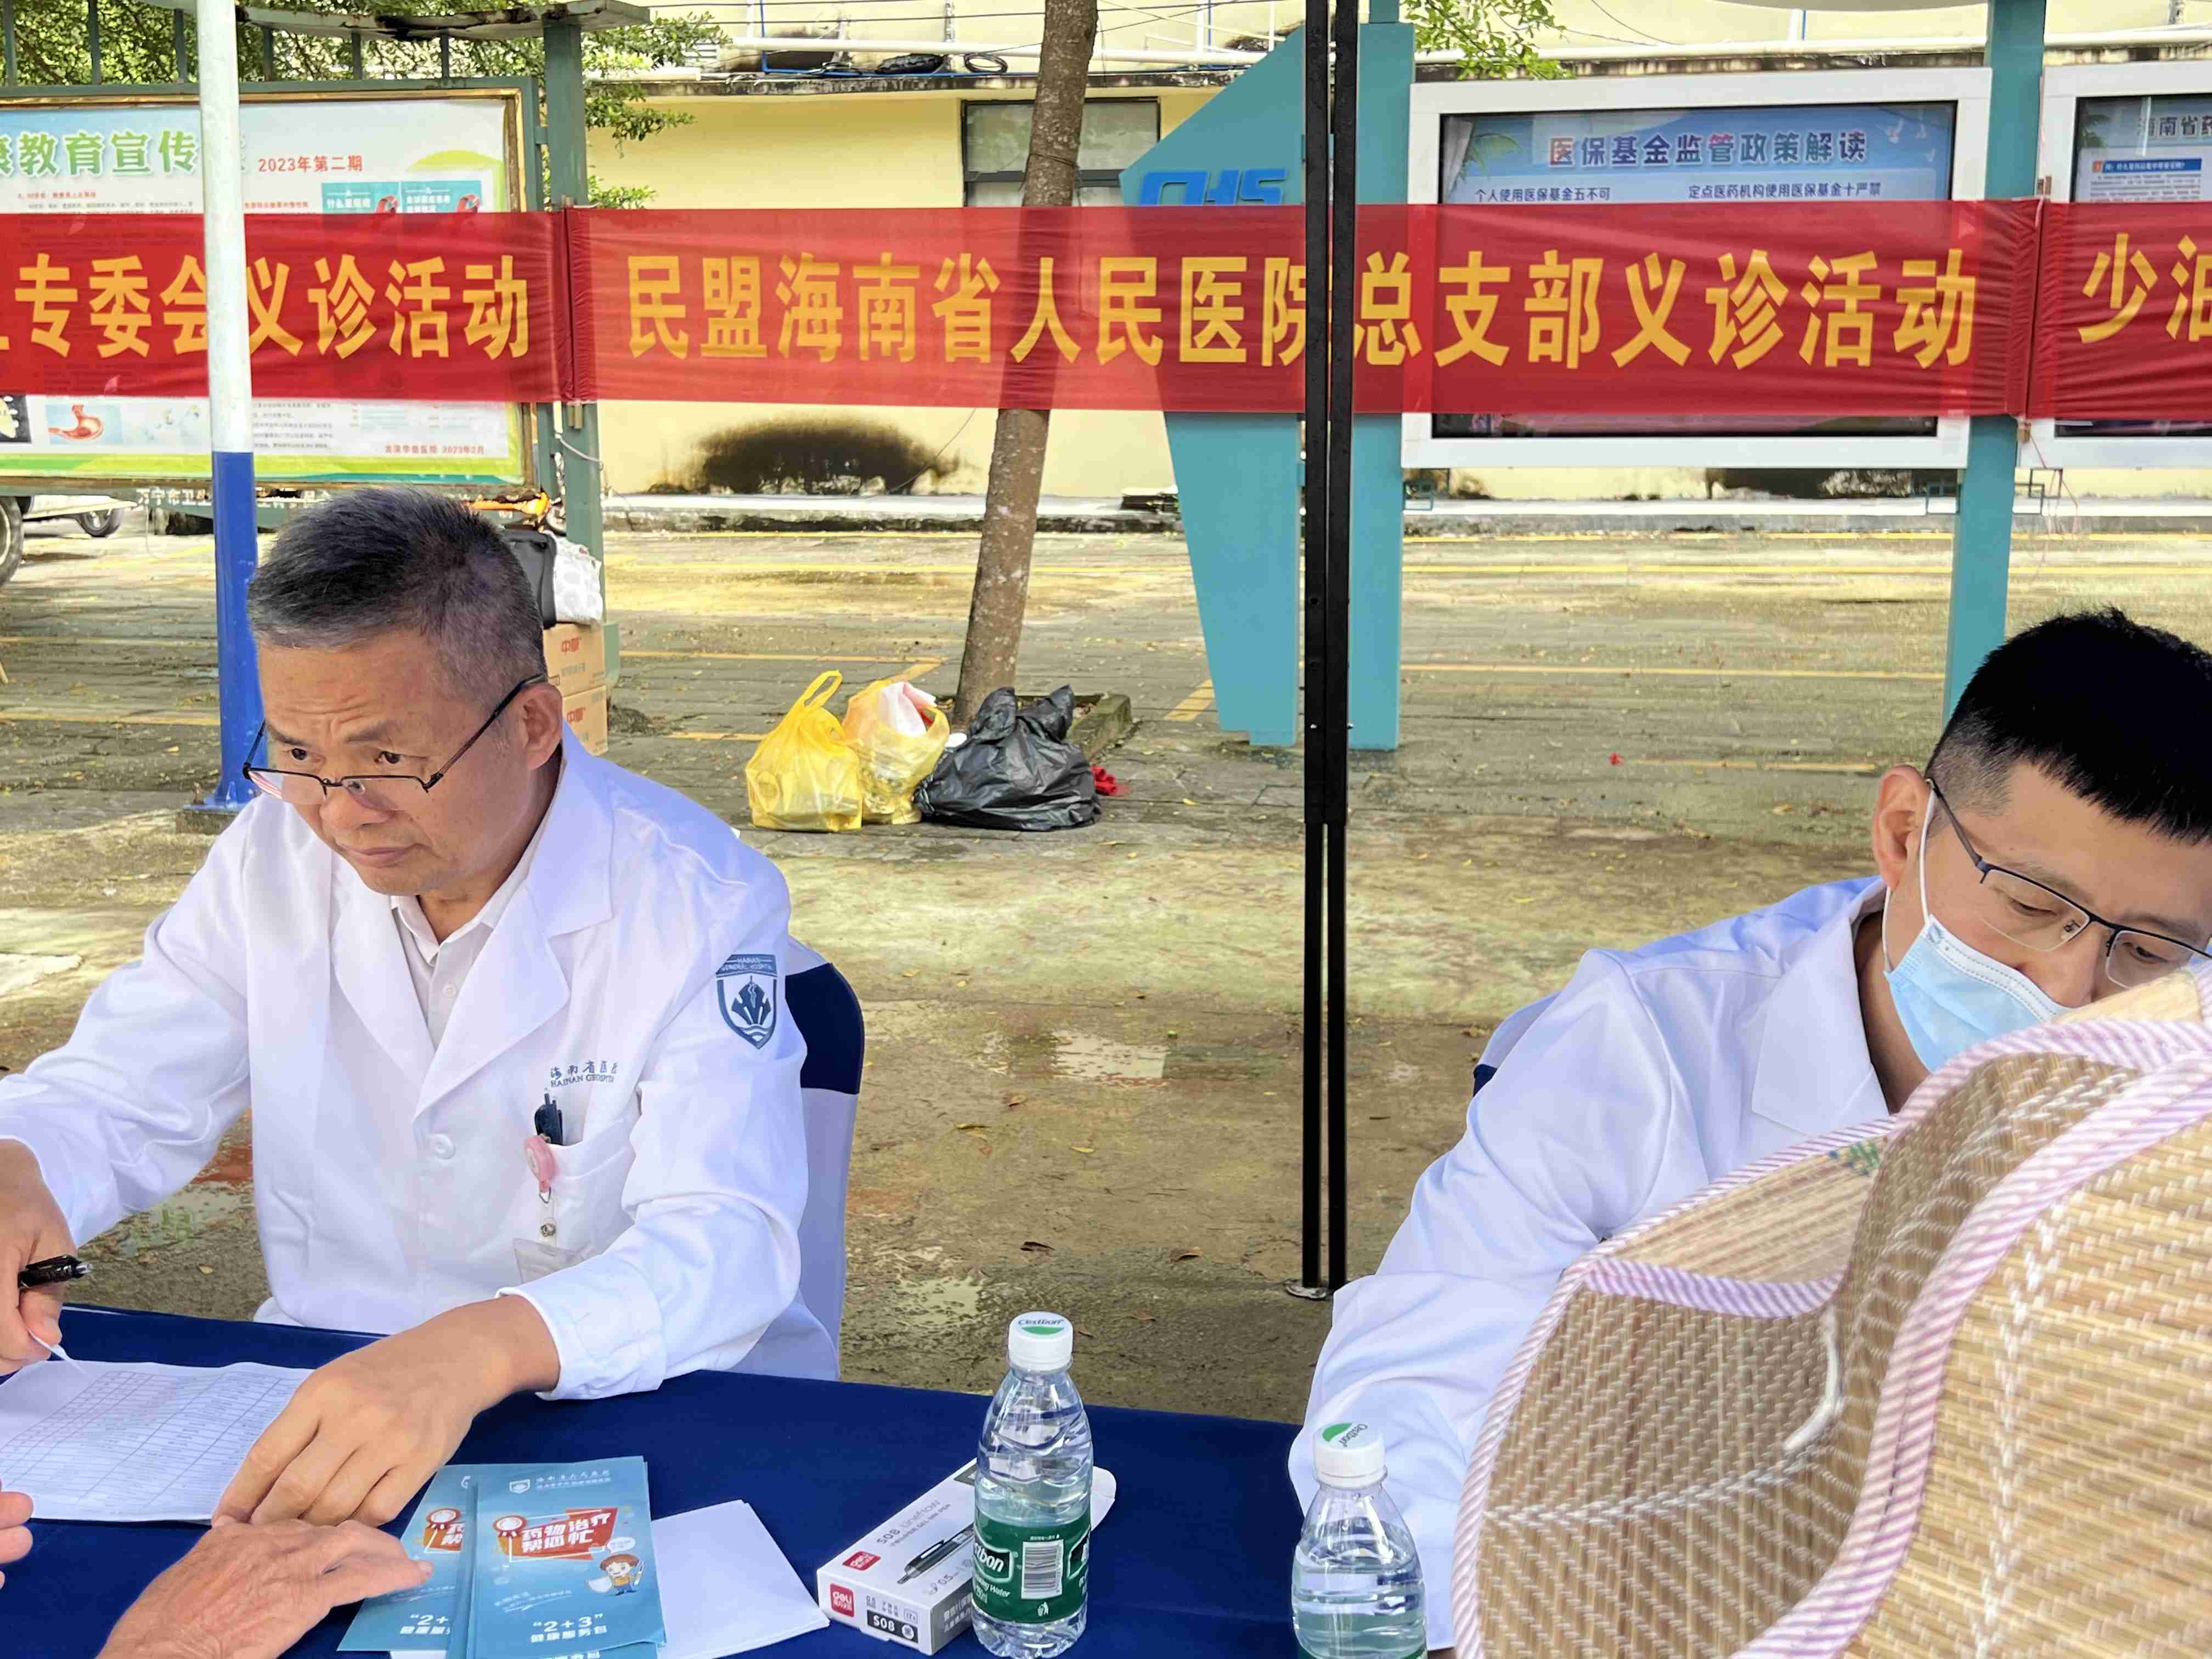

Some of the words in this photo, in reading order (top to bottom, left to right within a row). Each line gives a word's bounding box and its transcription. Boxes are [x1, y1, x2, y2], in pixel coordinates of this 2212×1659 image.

[258, 156, 363, 172] 2023年第二期
[1549, 132, 1866, 166] 医保基金监管政策解读
[1476, 187, 1611, 202] 个人使用医保基金五不可
[0, 252, 531, 361] 专委会义诊活动
[627, 249, 1977, 370] 民盟海南省人民医院总支部义诊活动
